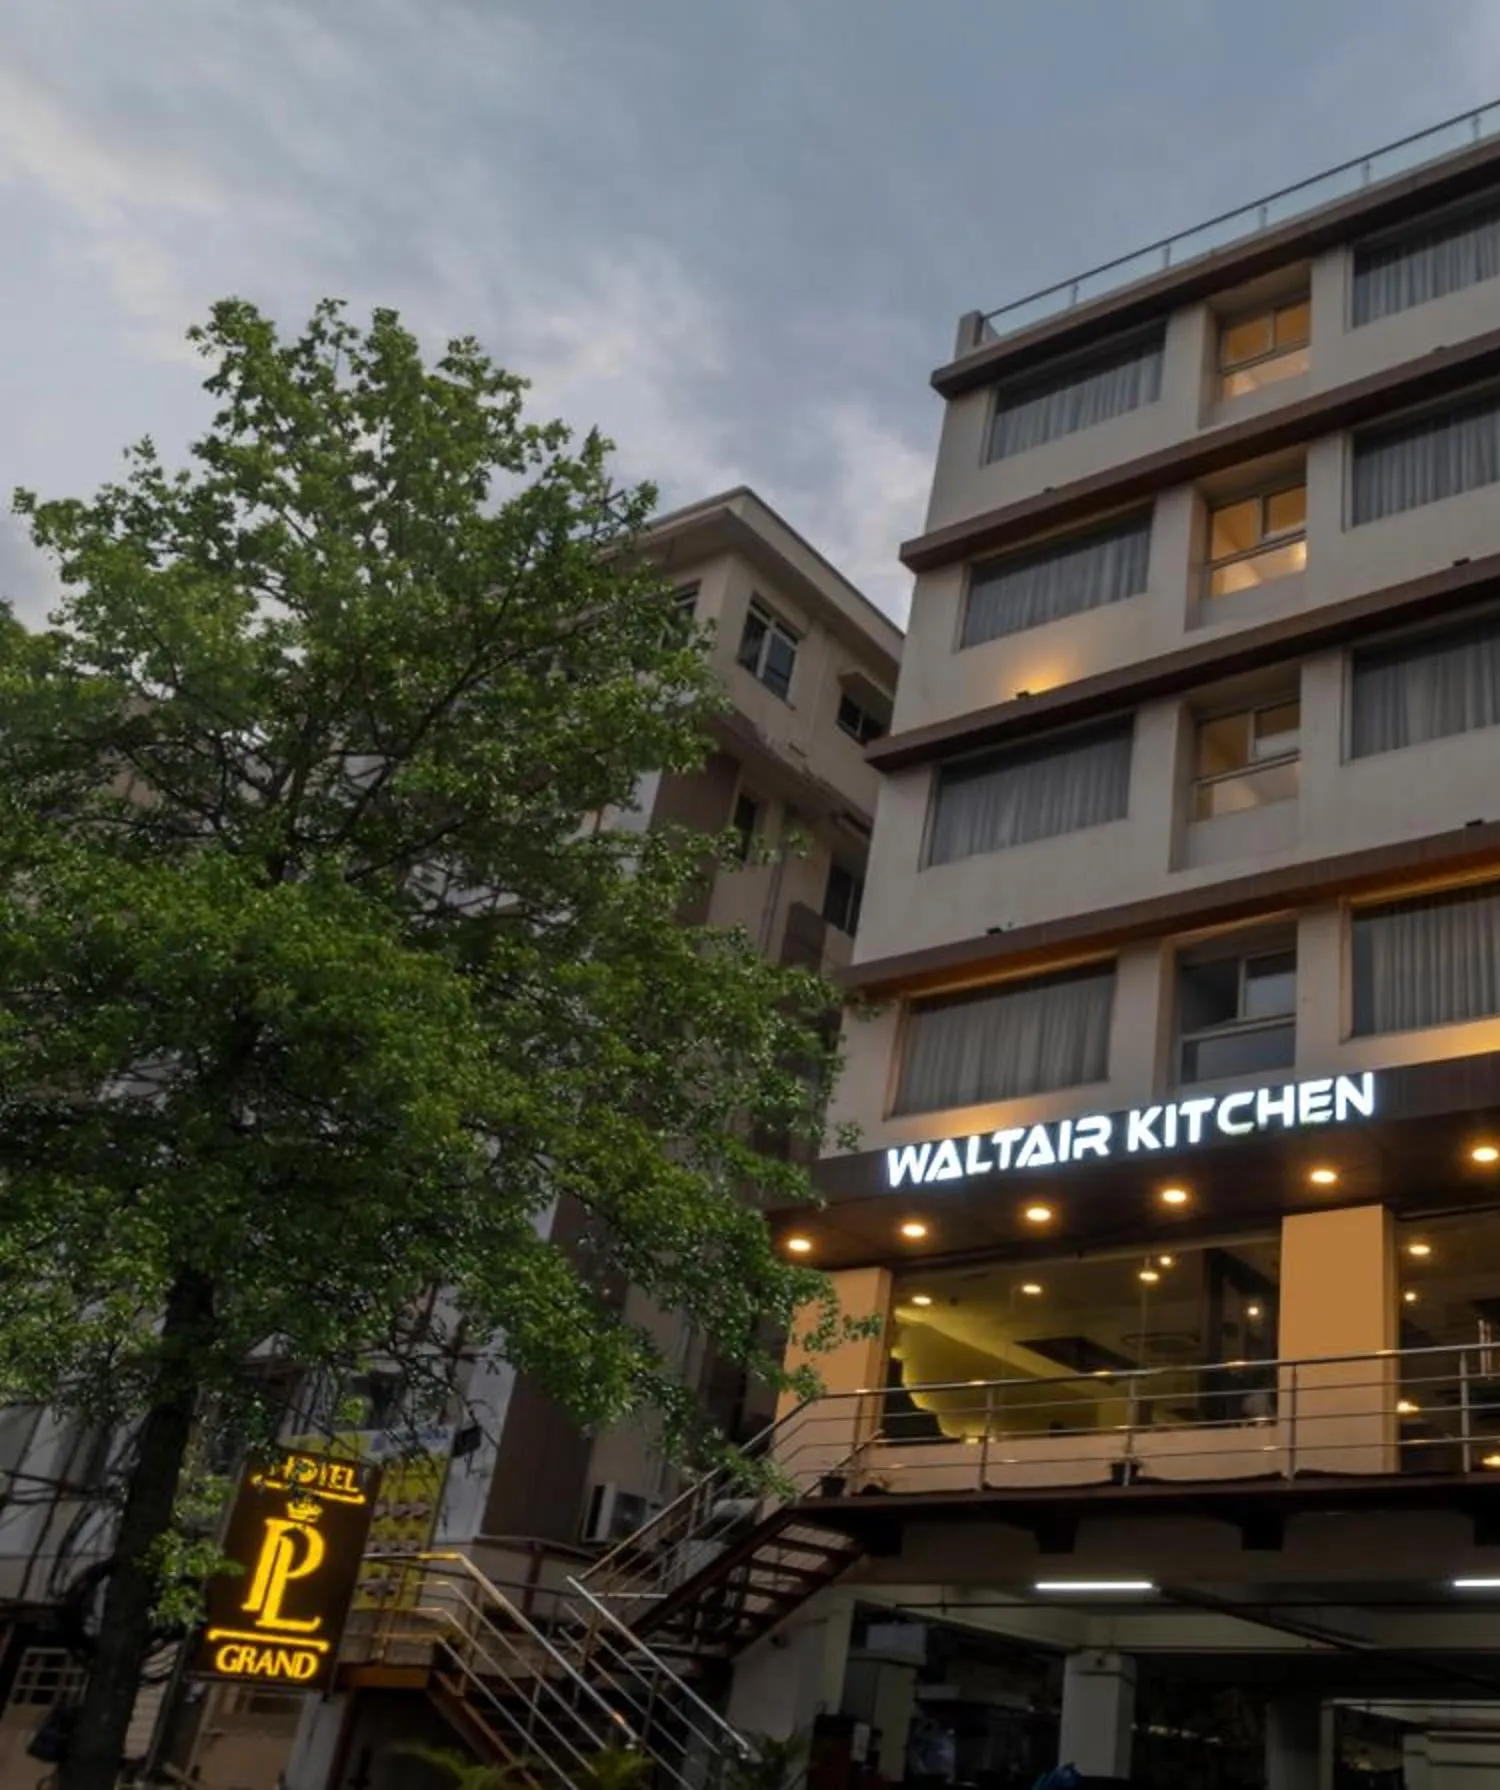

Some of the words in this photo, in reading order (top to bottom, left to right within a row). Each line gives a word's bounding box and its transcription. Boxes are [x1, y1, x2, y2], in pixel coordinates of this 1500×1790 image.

[887, 1114, 1111, 1188] WALTAIR
[1126, 1071, 1374, 1153] KITCHEN
[215, 1643, 319, 1680] GRAND
